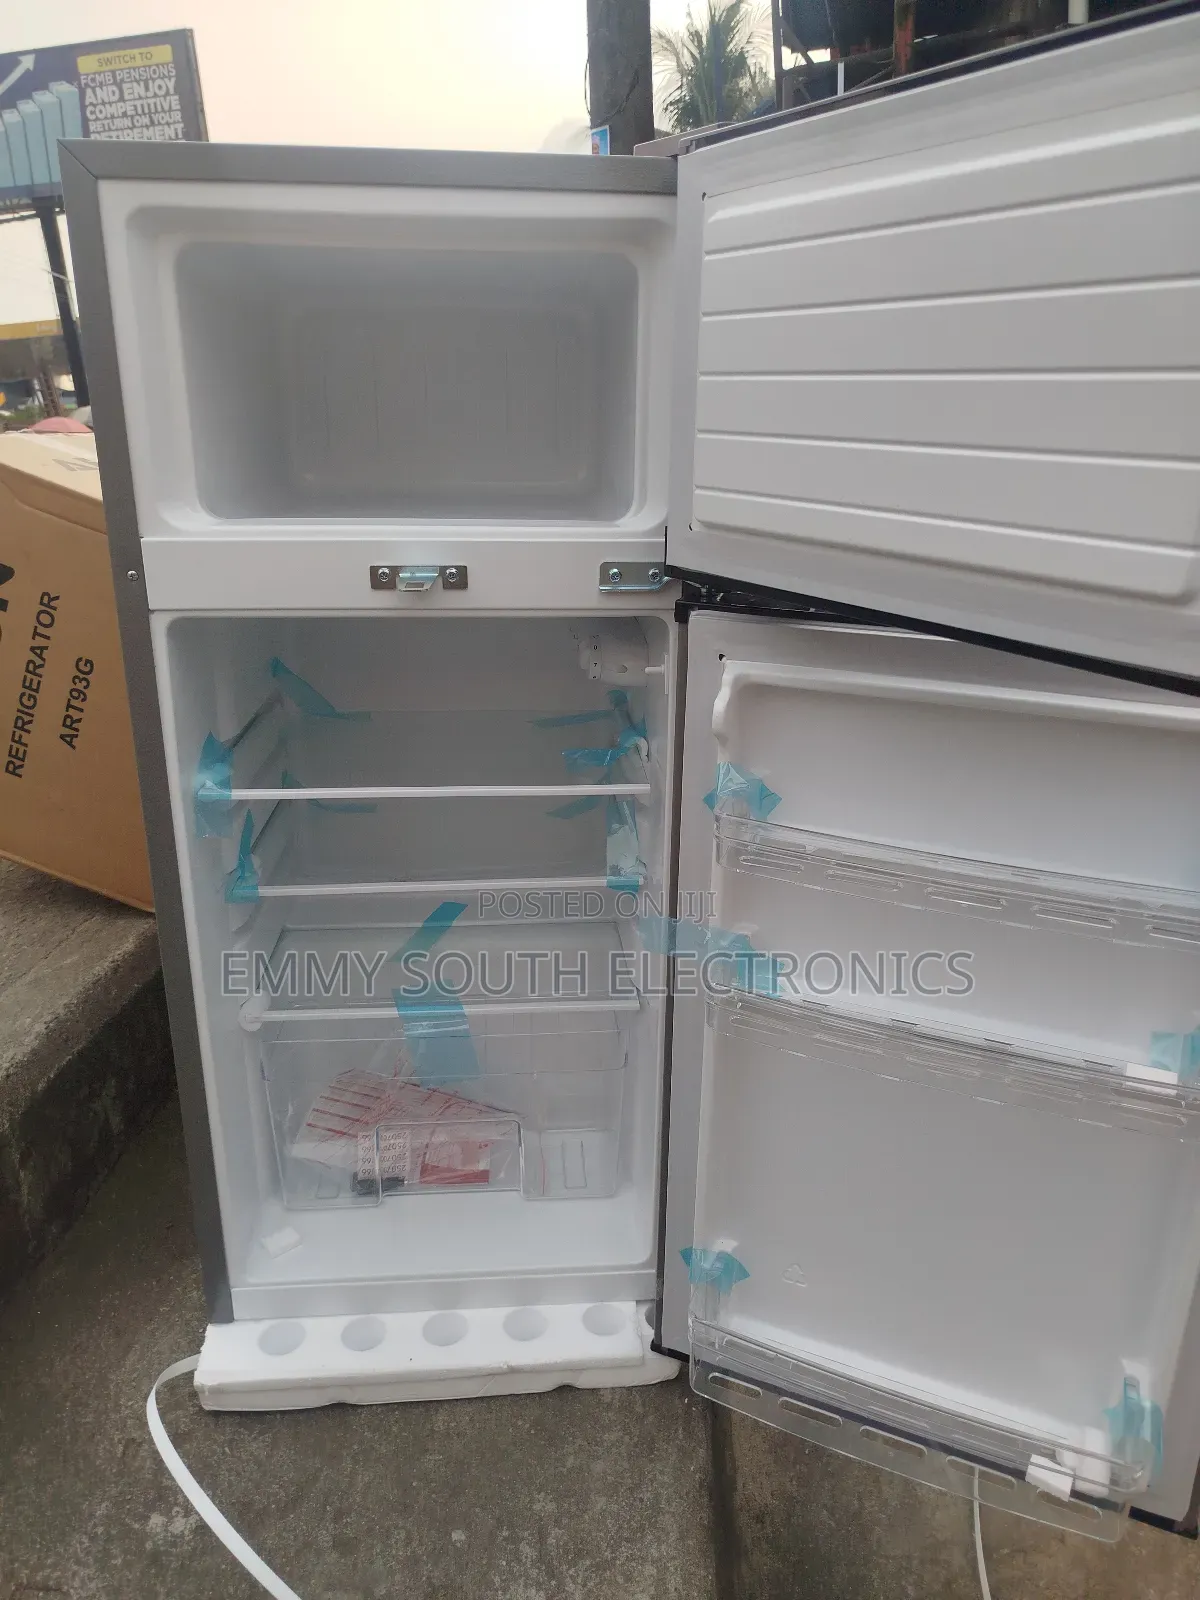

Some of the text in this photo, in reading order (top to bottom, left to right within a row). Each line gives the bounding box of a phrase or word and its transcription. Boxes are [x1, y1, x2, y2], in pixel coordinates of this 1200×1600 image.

[97, 52, 153, 67] SWITCH TO
[80, 63, 176, 88] FCMB PENSIONS
[85, 77, 177, 105] AND ENJOY
[86, 95, 181, 120] COMPETITIVE
[88, 111, 182, 132] RETURN ON YOUR
[5, 591, 60, 778] REFRIGERATOR
[59, 656, 94, 750] ART93G
